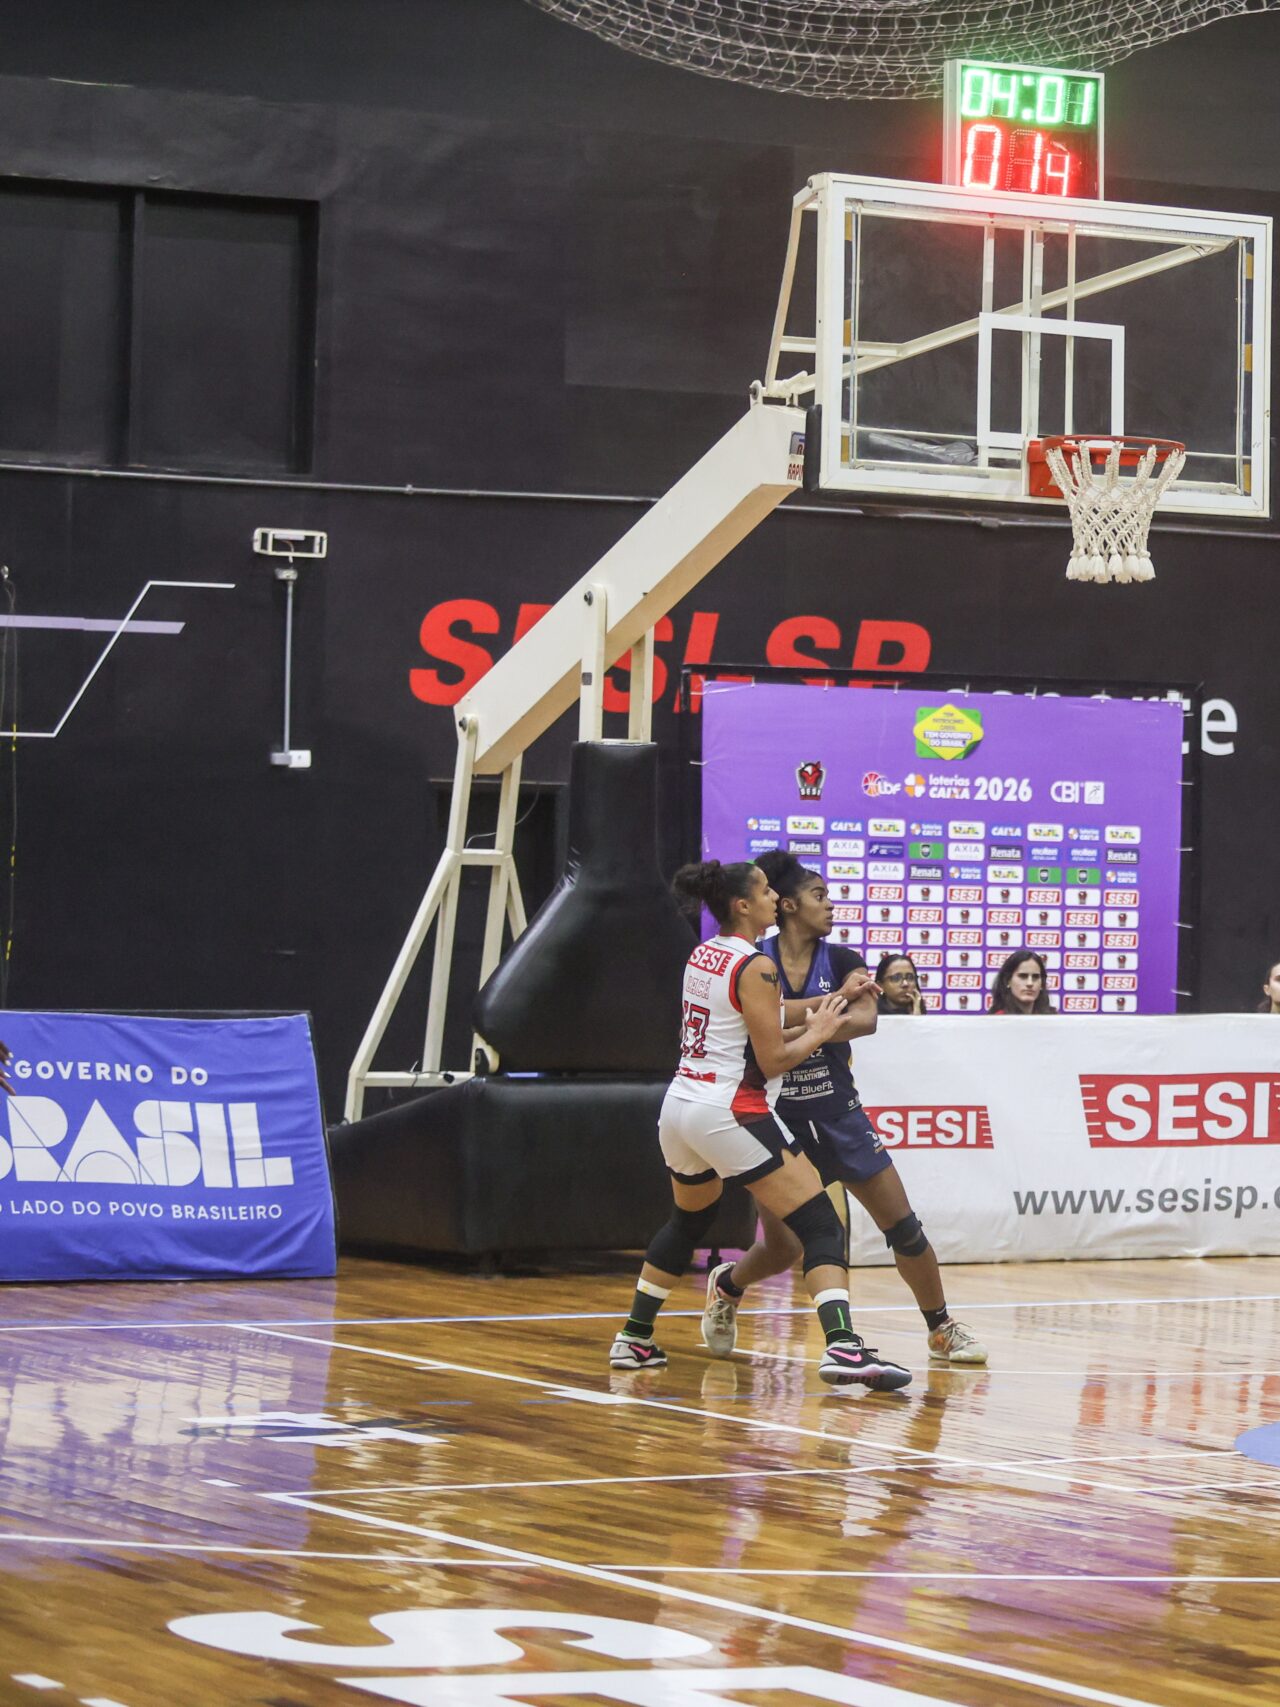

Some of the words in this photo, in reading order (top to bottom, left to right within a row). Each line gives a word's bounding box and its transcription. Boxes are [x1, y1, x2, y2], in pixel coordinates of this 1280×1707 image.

[962, 69, 1094, 125] 04:01
[929, 774, 970, 787] loterias
[929, 787, 970, 799] CAIXA
[973, 776, 1033, 802] 2026
[870, 888, 898, 900] SESI
[951, 890, 978, 902] SESI
[1030, 891, 1058, 903] SESI
[1108, 893, 1135, 905] SESI
[911, 910, 939, 922] SESI
[991, 911, 1018, 923] SESI
[1069, 913, 1096, 925] SESI
[870, 931, 898, 943] SESI
[950, 933, 978, 945] SESI
[1030, 934, 1058, 946] SESI
[1108, 935, 1134, 947] SESI
[690, 945, 725, 973] SESI
[1068, 956, 1096, 967] SESI
[950, 974, 977, 986] SESI
[1107, 978, 1134, 990] SESI
[1067, 998, 1095, 1010] SESI
[14, 1061, 153, 1083] GOVERNO
[171, 1066, 208, 1086] DO
[801, 1080, 834, 1095] BlueFit
[1105, 1081, 1270, 1142] SESI
[876, 1110, 977, 1146] SESI
[0, 1096, 294, 1188] RASIL
[11, 1200, 64, 1215] LADO
[72, 1201, 101, 1216] DO
[109, 1201, 163, 1218] POVO
[172, 1204, 282, 1221] BRASILEIRO
